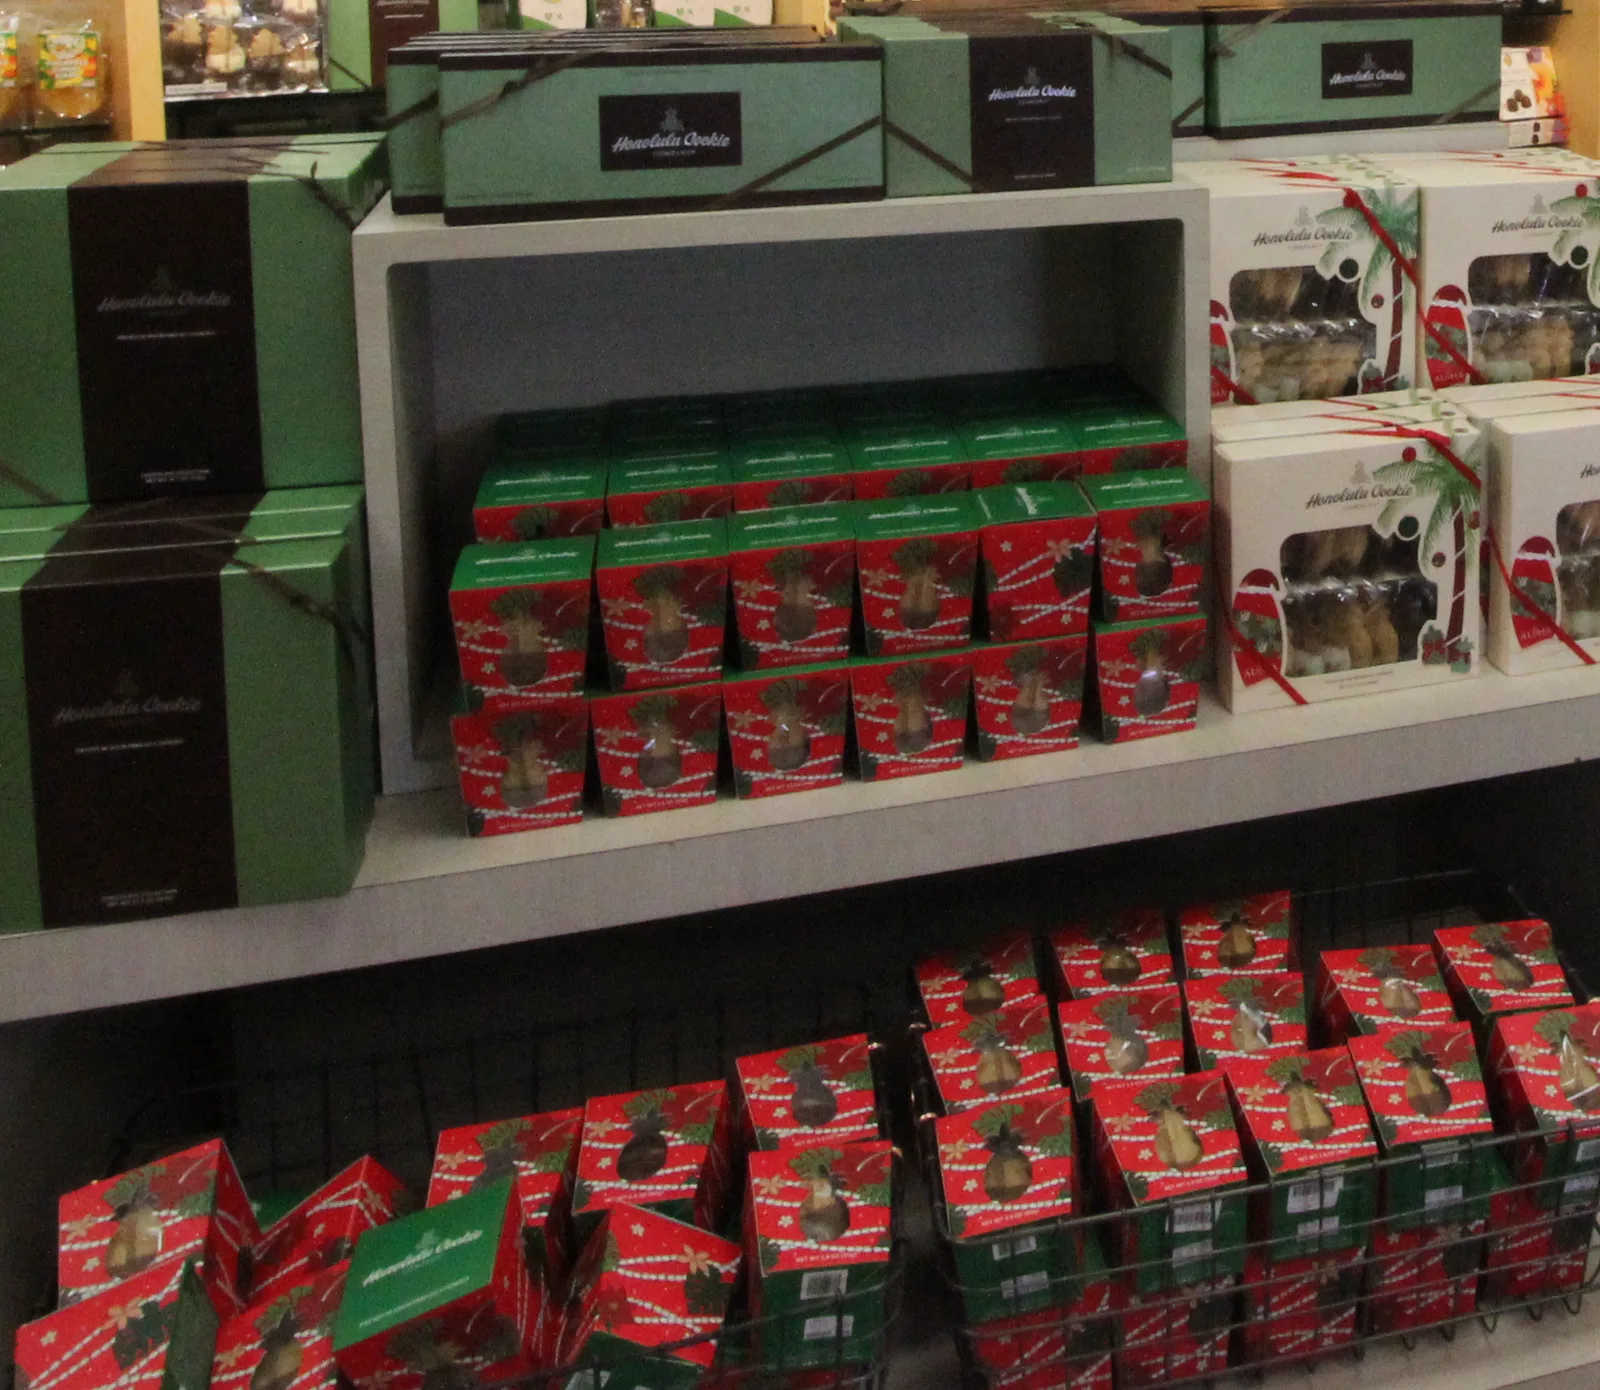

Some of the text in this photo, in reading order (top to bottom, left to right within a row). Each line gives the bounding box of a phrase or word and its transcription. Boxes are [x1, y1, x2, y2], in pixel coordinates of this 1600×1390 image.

[988, 84, 1077, 101] Honolulu Cookie
[611, 131, 731, 153] Honolulu Cookie
[1492, 214, 1584, 233] Honolulu Cookie
[1253, 227, 1354, 247] Honolulu Cookie
[1305, 485, 1369, 509] Honolulu
[1371, 483, 1413, 498] Cookie
